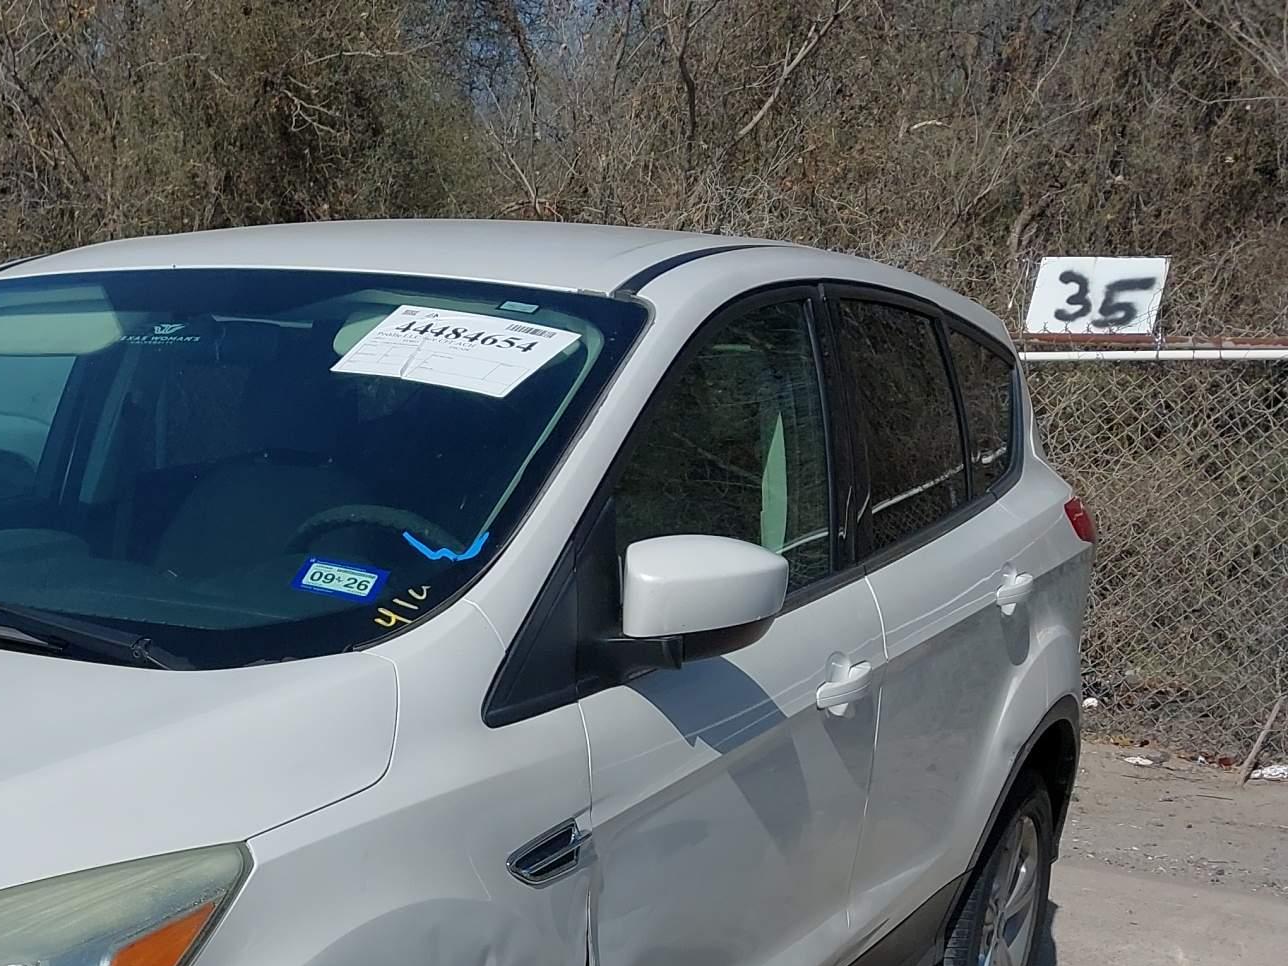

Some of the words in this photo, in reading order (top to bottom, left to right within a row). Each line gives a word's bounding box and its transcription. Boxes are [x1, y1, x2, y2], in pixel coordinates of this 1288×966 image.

[1054, 269, 1157, 329] 35
[395, 320, 540, 353] 44484654
[310, 570, 336, 584] 09
[343, 577, 371, 591] 26
